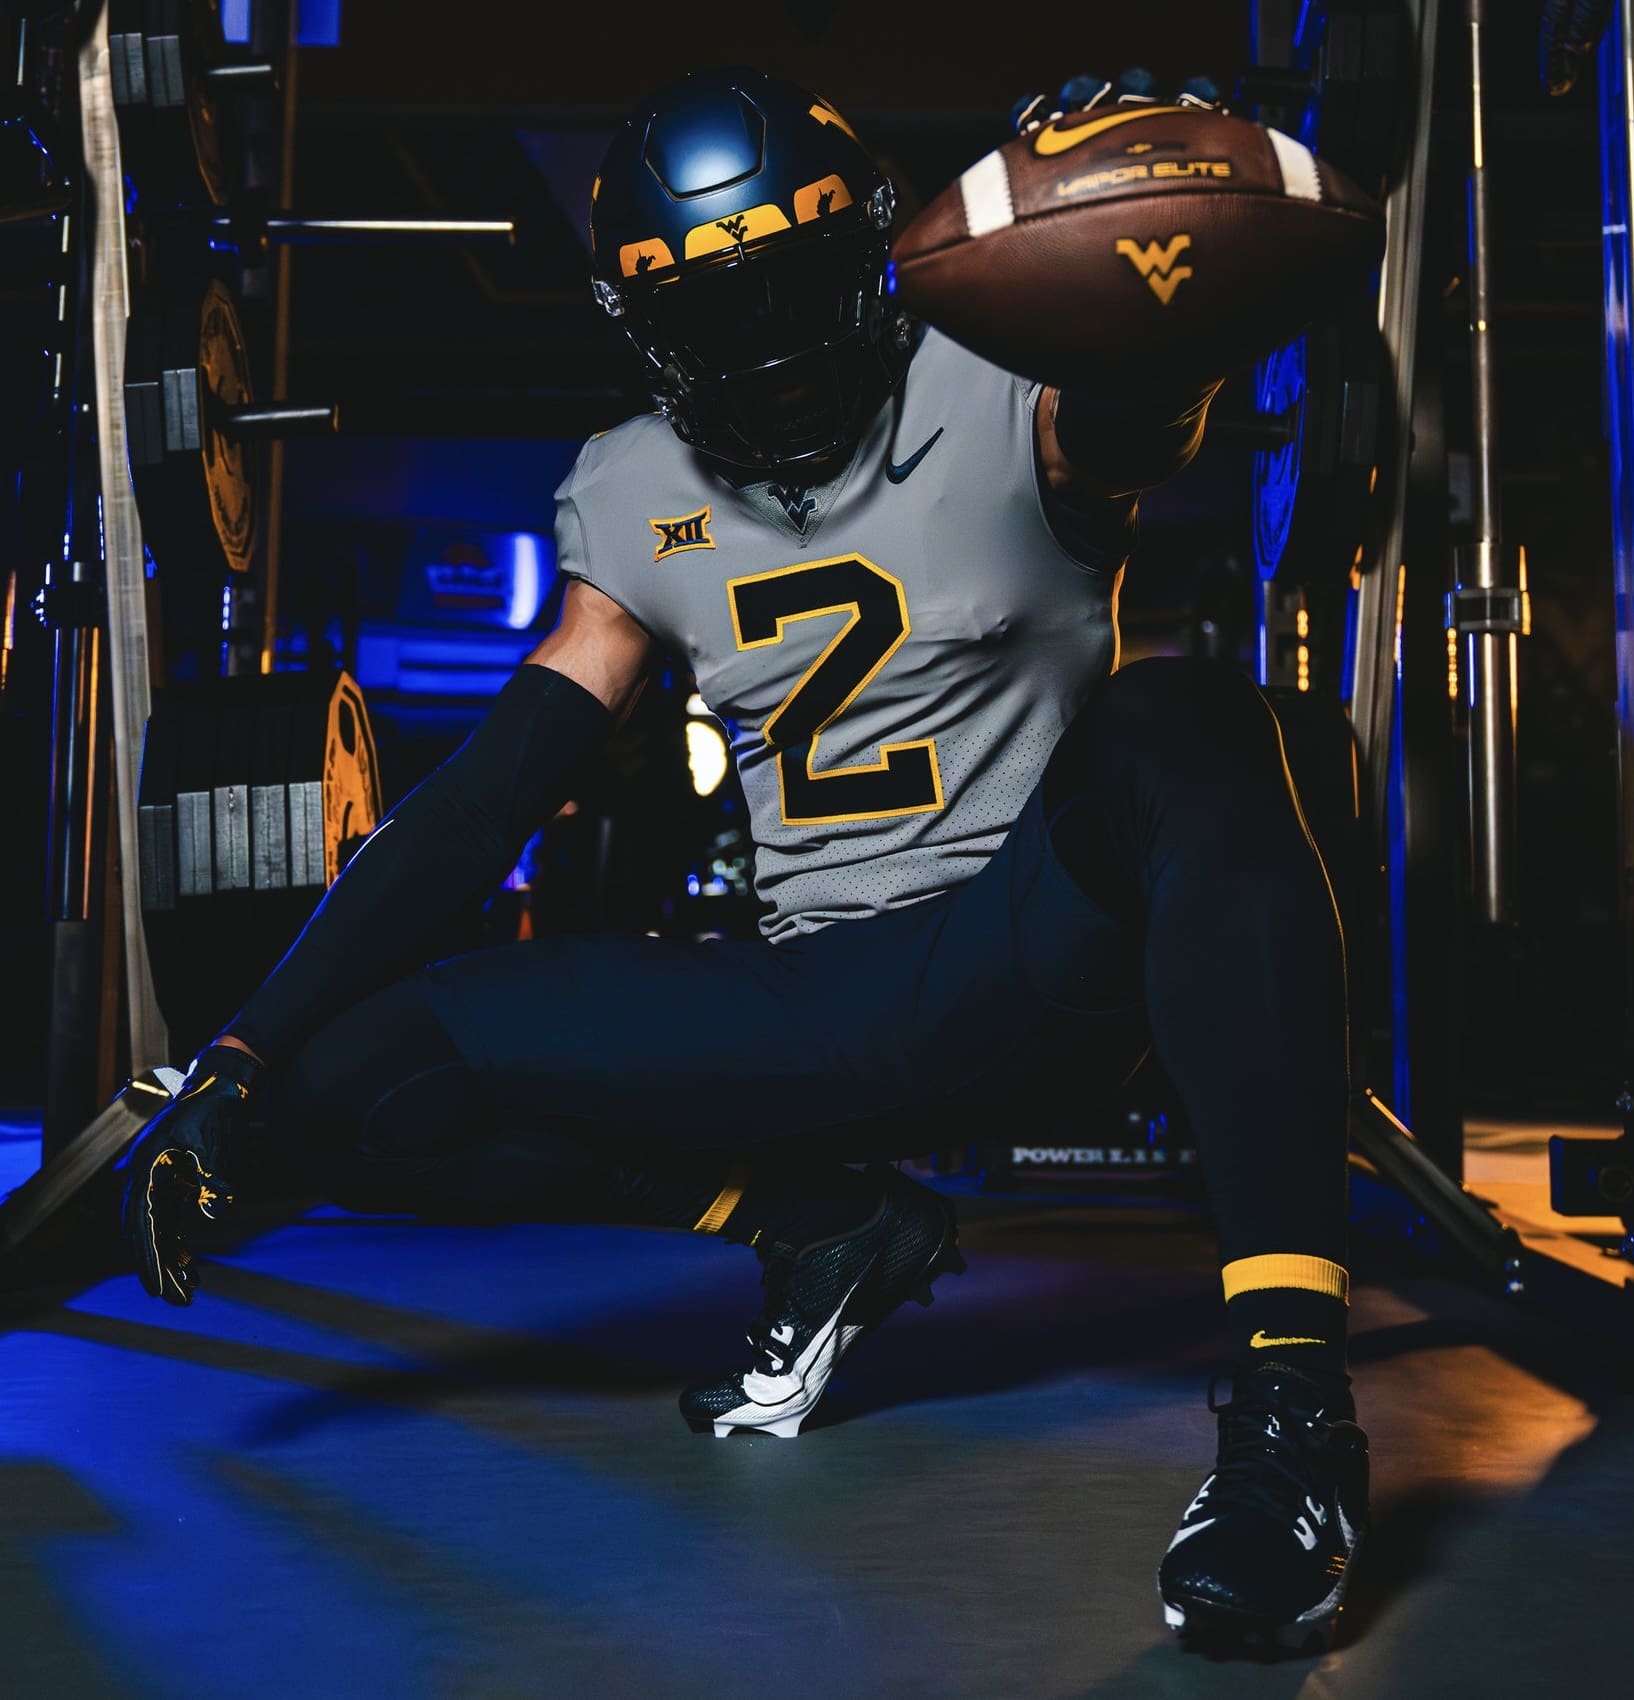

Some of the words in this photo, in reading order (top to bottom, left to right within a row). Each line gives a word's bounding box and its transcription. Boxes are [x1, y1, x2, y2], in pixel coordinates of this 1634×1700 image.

[1151, 161, 1232, 178] ELITE
[654, 511, 710, 555] XII
[726, 552, 944, 826] 2
